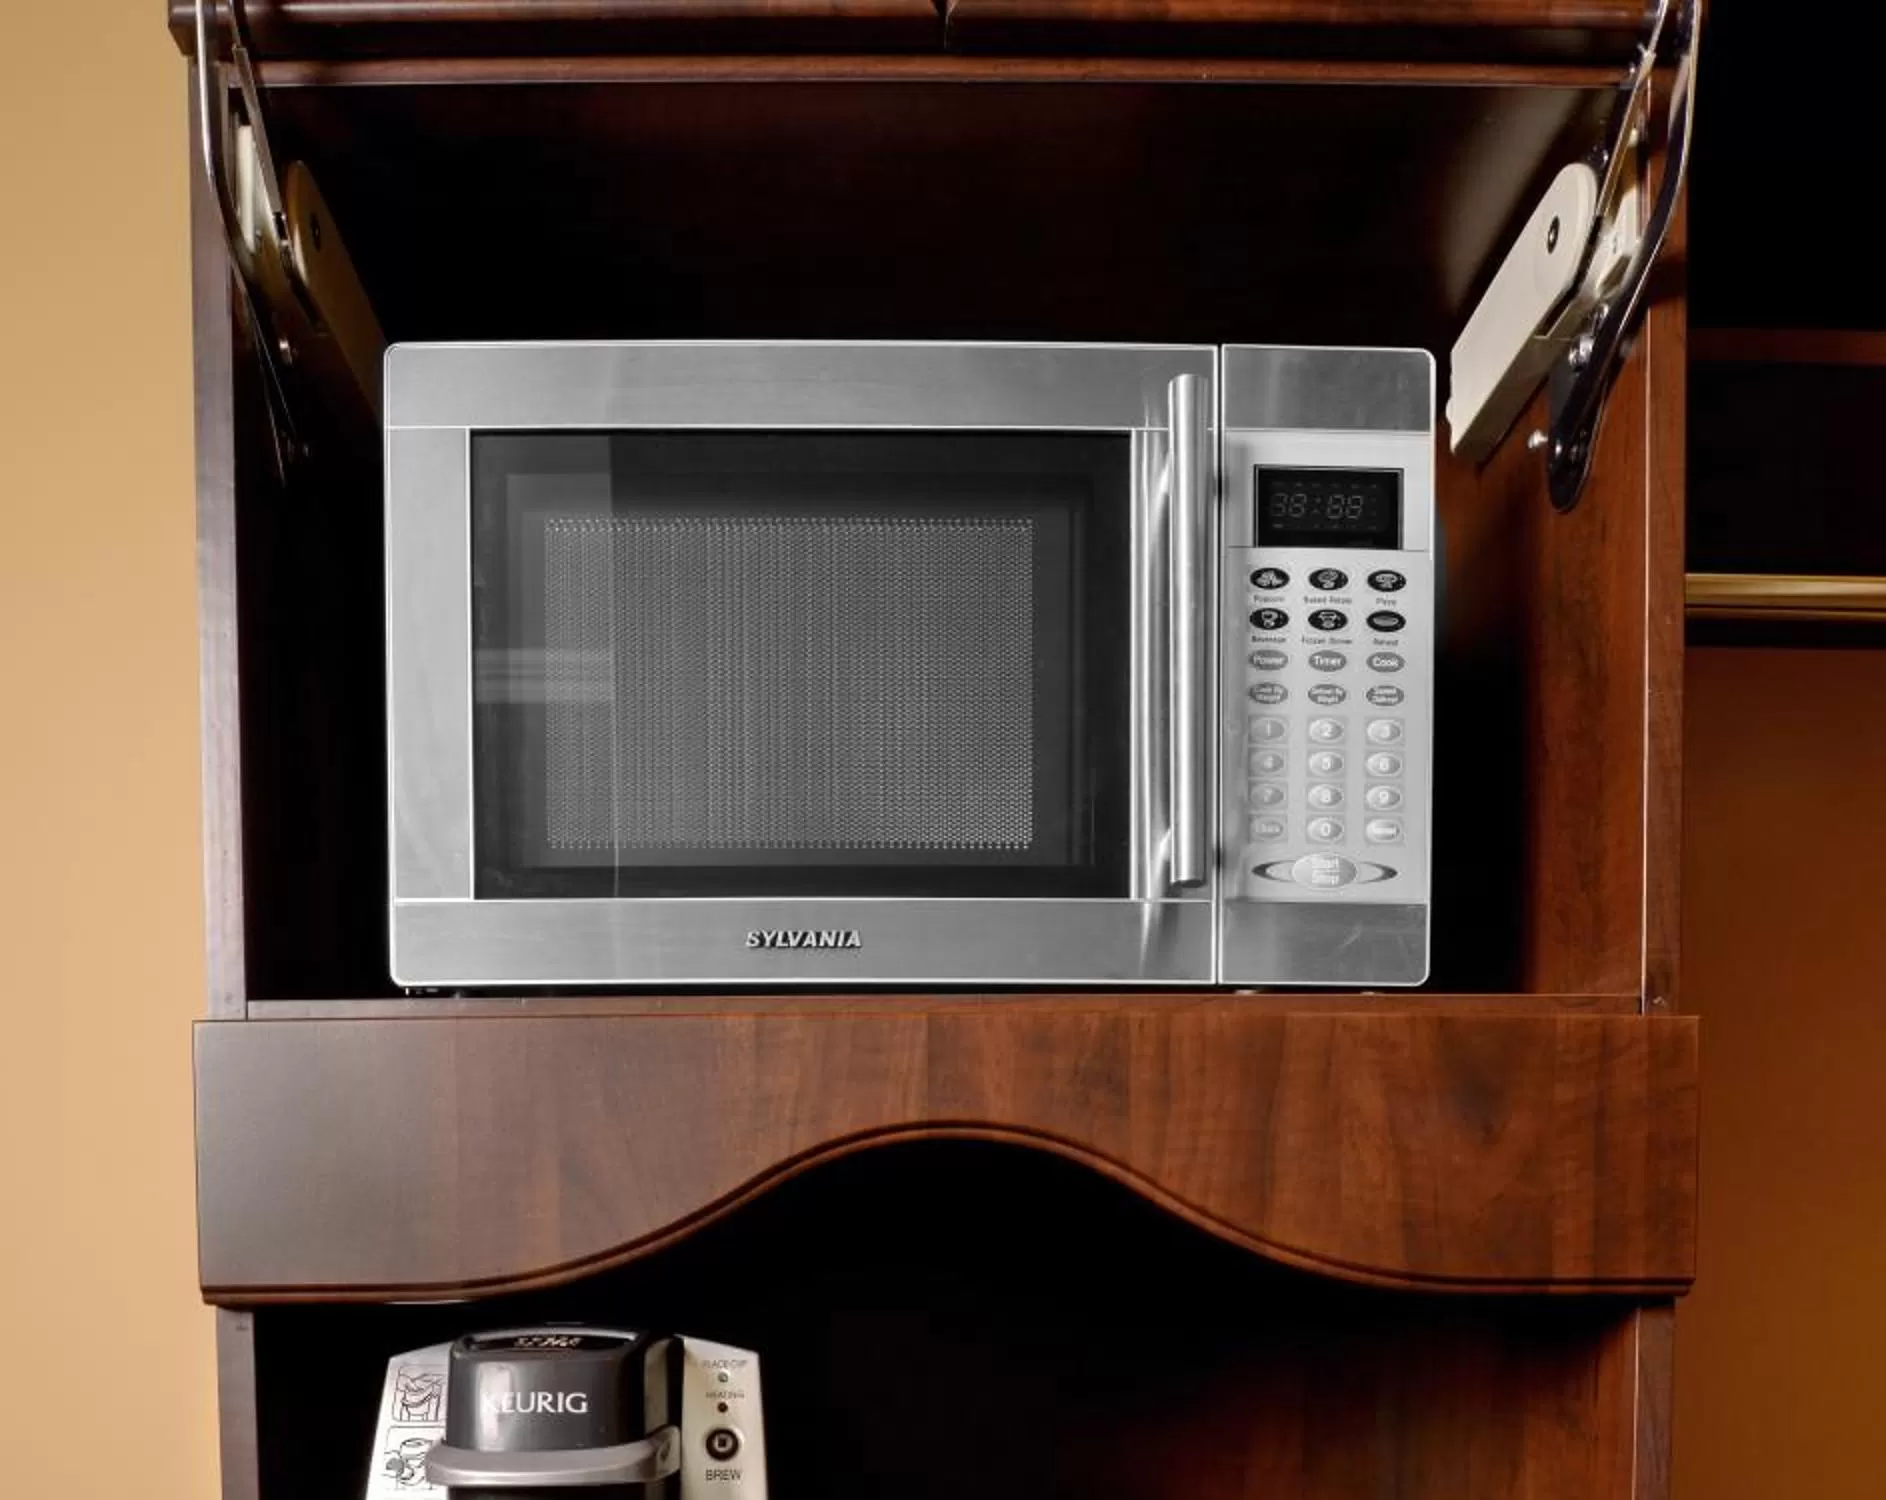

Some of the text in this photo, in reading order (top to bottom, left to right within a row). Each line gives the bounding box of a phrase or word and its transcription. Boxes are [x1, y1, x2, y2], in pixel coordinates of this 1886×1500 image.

[746, 929, 862, 948] SYLVANIA
[481, 1391, 588, 1413] KEURIG
[705, 1468, 743, 1482] BREW
